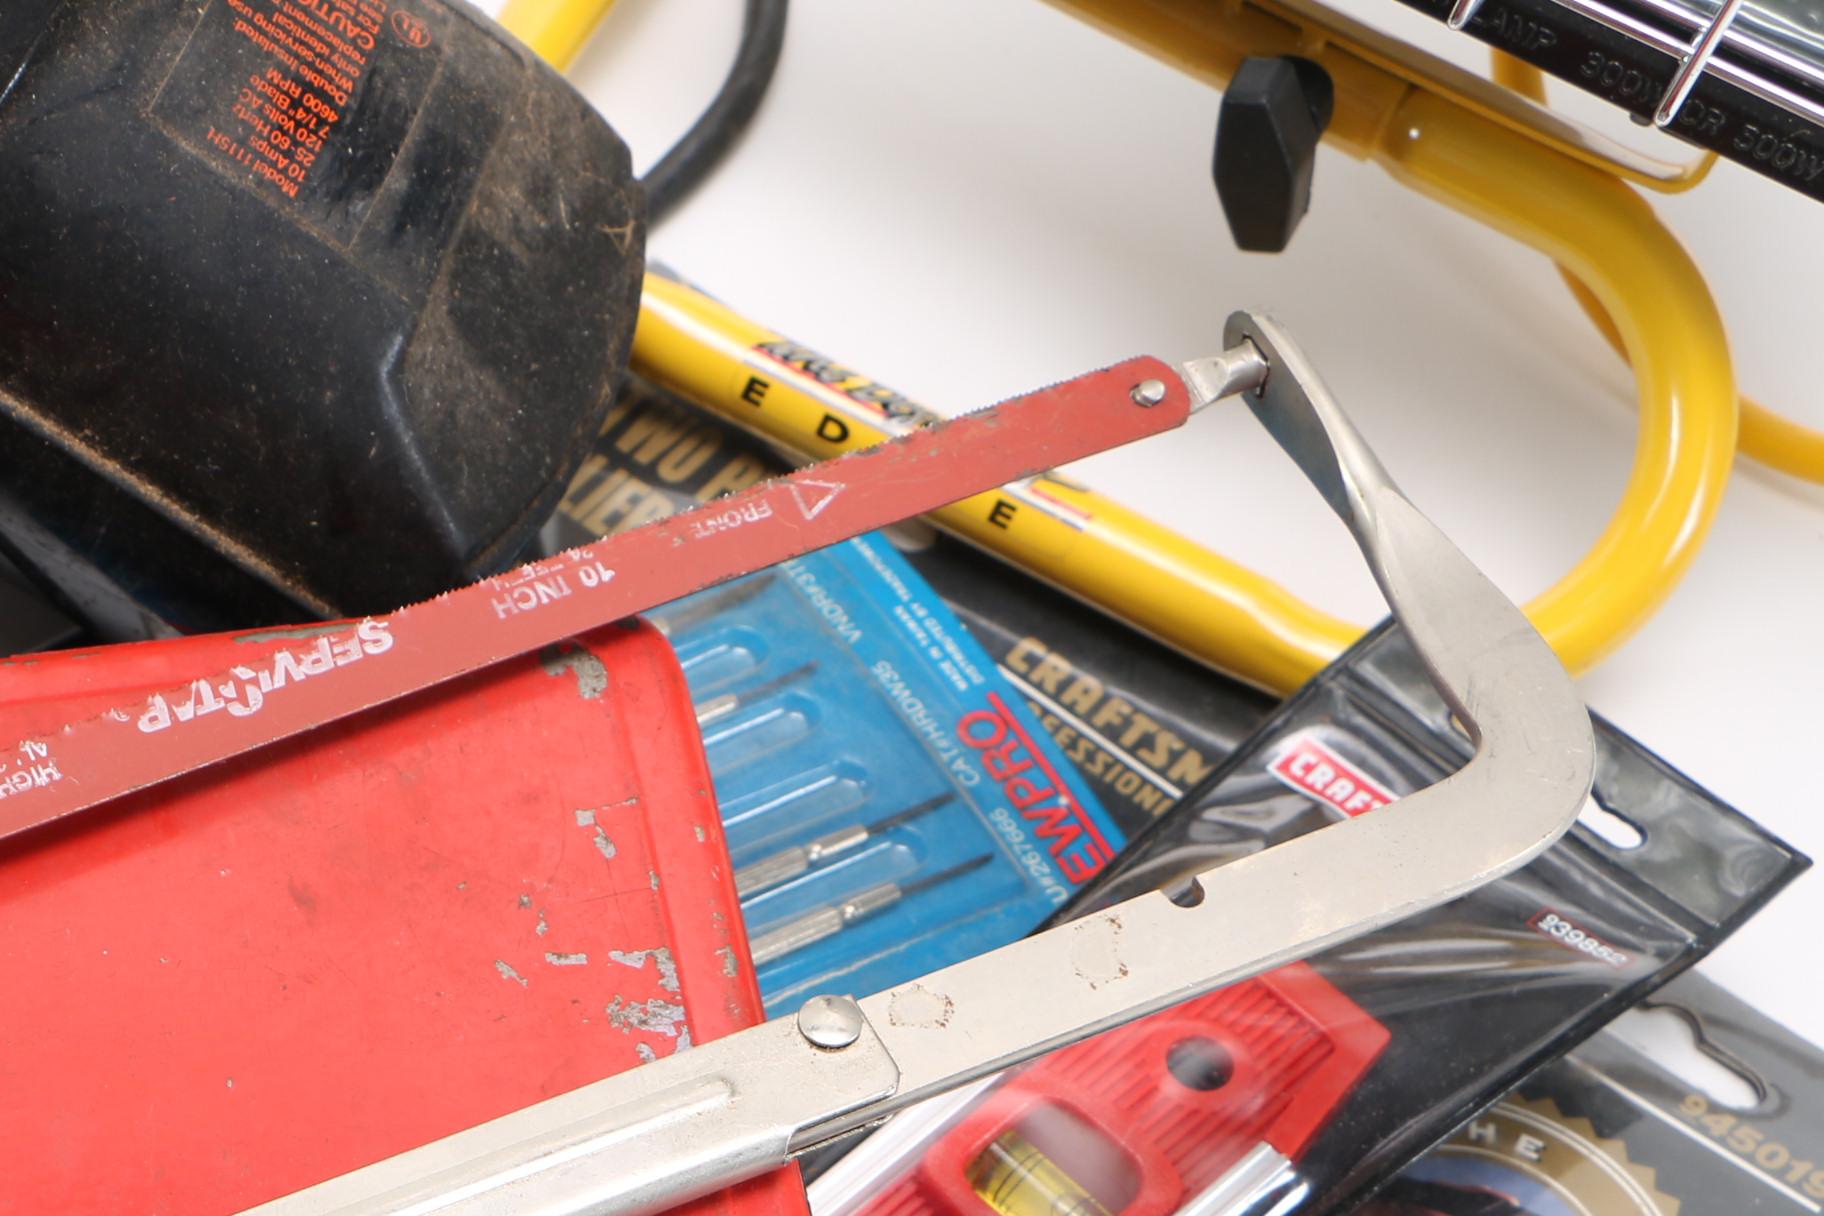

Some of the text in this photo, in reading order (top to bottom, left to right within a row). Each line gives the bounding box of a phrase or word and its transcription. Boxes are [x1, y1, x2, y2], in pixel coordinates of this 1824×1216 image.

[271, 11, 361, 77] only identical
[281, 1, 368, 65] replacement
[246, 73, 291, 110] Blade
[265, 66, 340, 123] 4600 RPM
[296, 63, 349, 106] Double
[229, 101, 270, 136] Hertz
[238, 87, 324, 151] 120 Volts AC
[246, 133, 307, 182] 10 Amps
[251, 158, 300, 198] Model
[490, 556, 616, 619] 10 INCH
